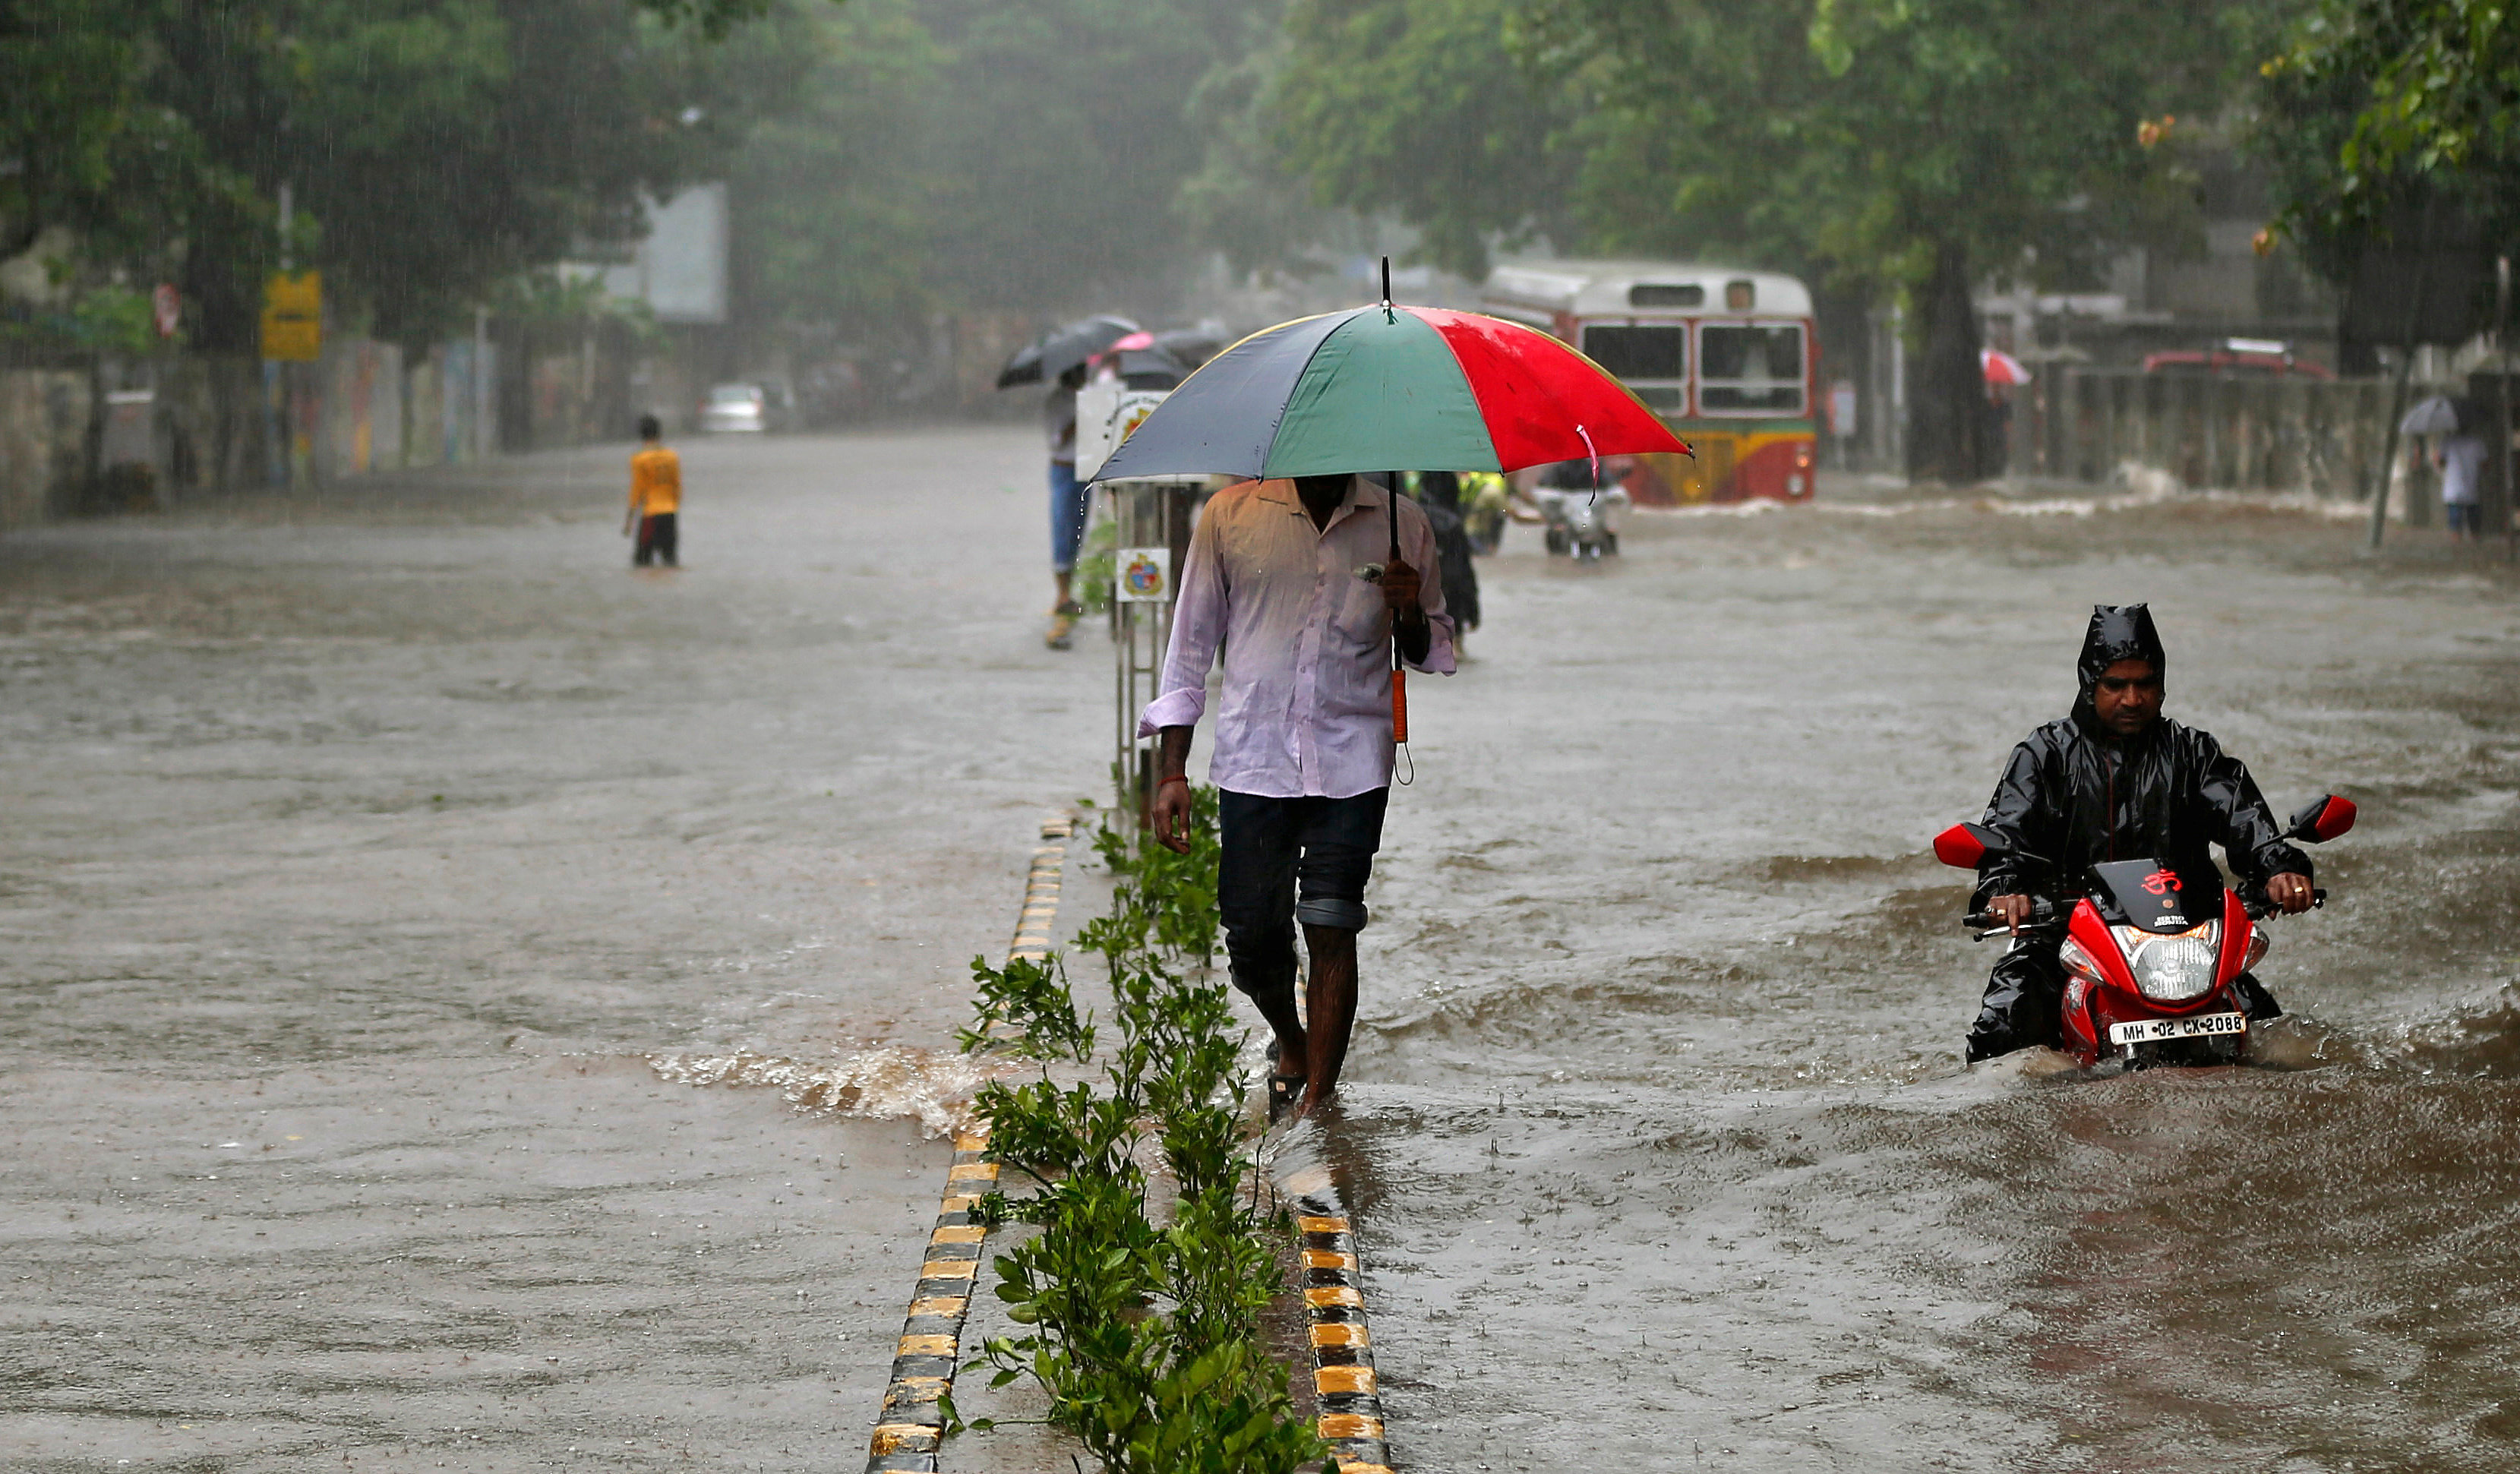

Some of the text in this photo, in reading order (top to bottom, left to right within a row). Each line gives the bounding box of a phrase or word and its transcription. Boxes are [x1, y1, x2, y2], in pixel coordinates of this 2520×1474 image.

[2124, 1016, 2242, 1040] MH 02 CX 2088
